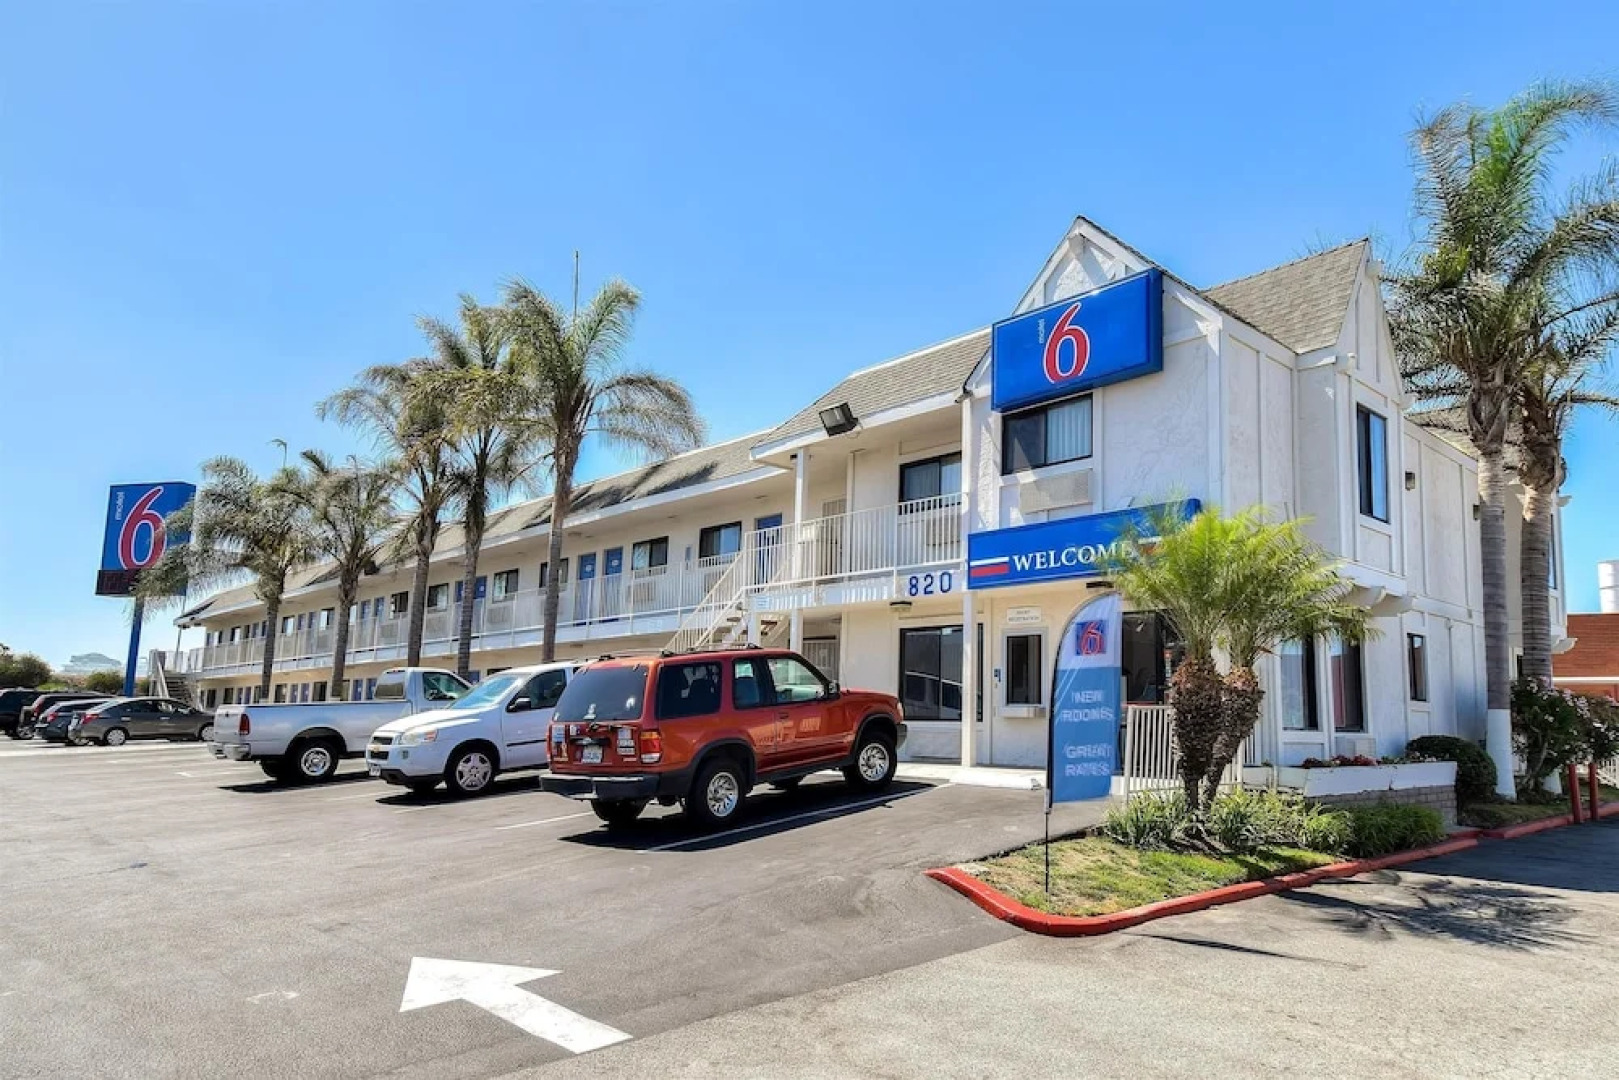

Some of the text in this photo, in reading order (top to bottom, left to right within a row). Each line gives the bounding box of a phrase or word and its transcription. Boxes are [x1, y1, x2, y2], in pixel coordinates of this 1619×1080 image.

[1043, 302, 1090, 384] 6
[118, 486, 167, 571] 6
[1012, 540, 1134, 571] WELCOME
[909, 571, 952, 596] 820
[1081, 620, 1105, 656] 6
